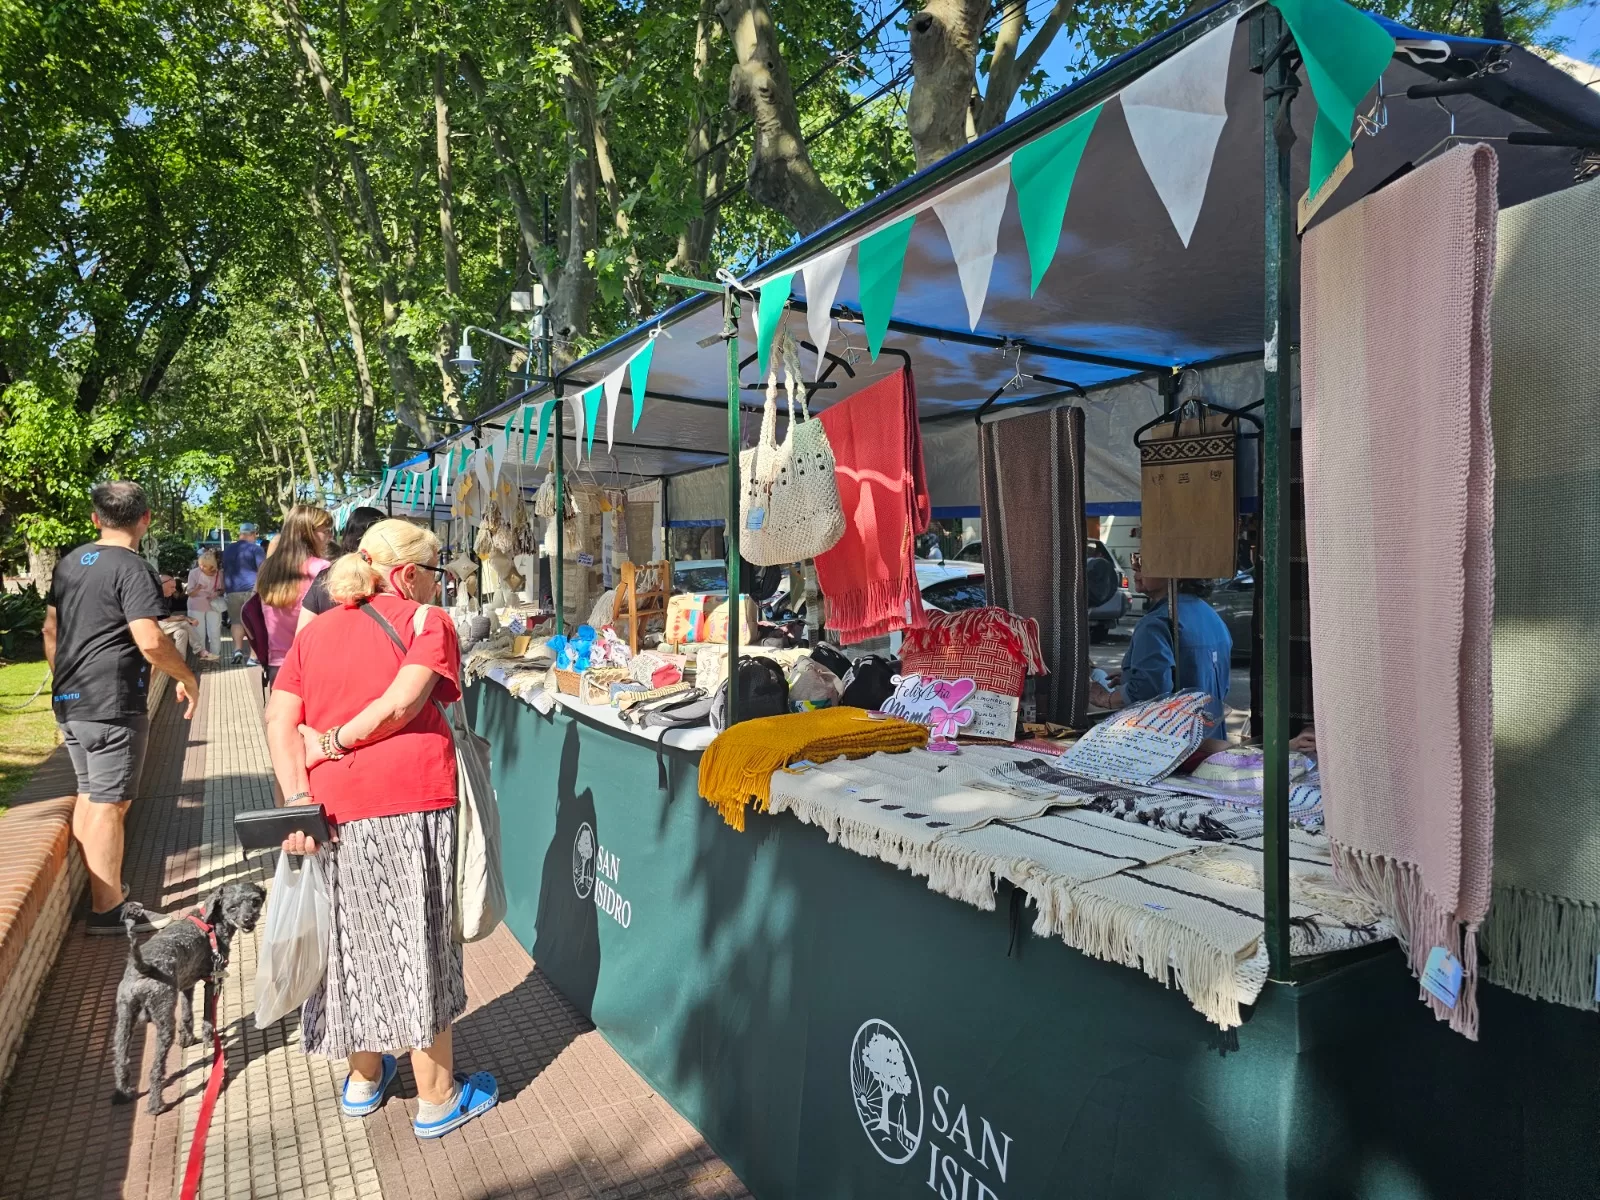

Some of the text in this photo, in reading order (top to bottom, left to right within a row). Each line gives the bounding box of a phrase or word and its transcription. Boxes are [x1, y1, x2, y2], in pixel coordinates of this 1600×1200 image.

[893, 675, 923, 703] Feliz
[596, 845, 621, 884] SAN
[593, 876, 632, 929] ISIDRO
[932, 1085, 1013, 1183] SAN
